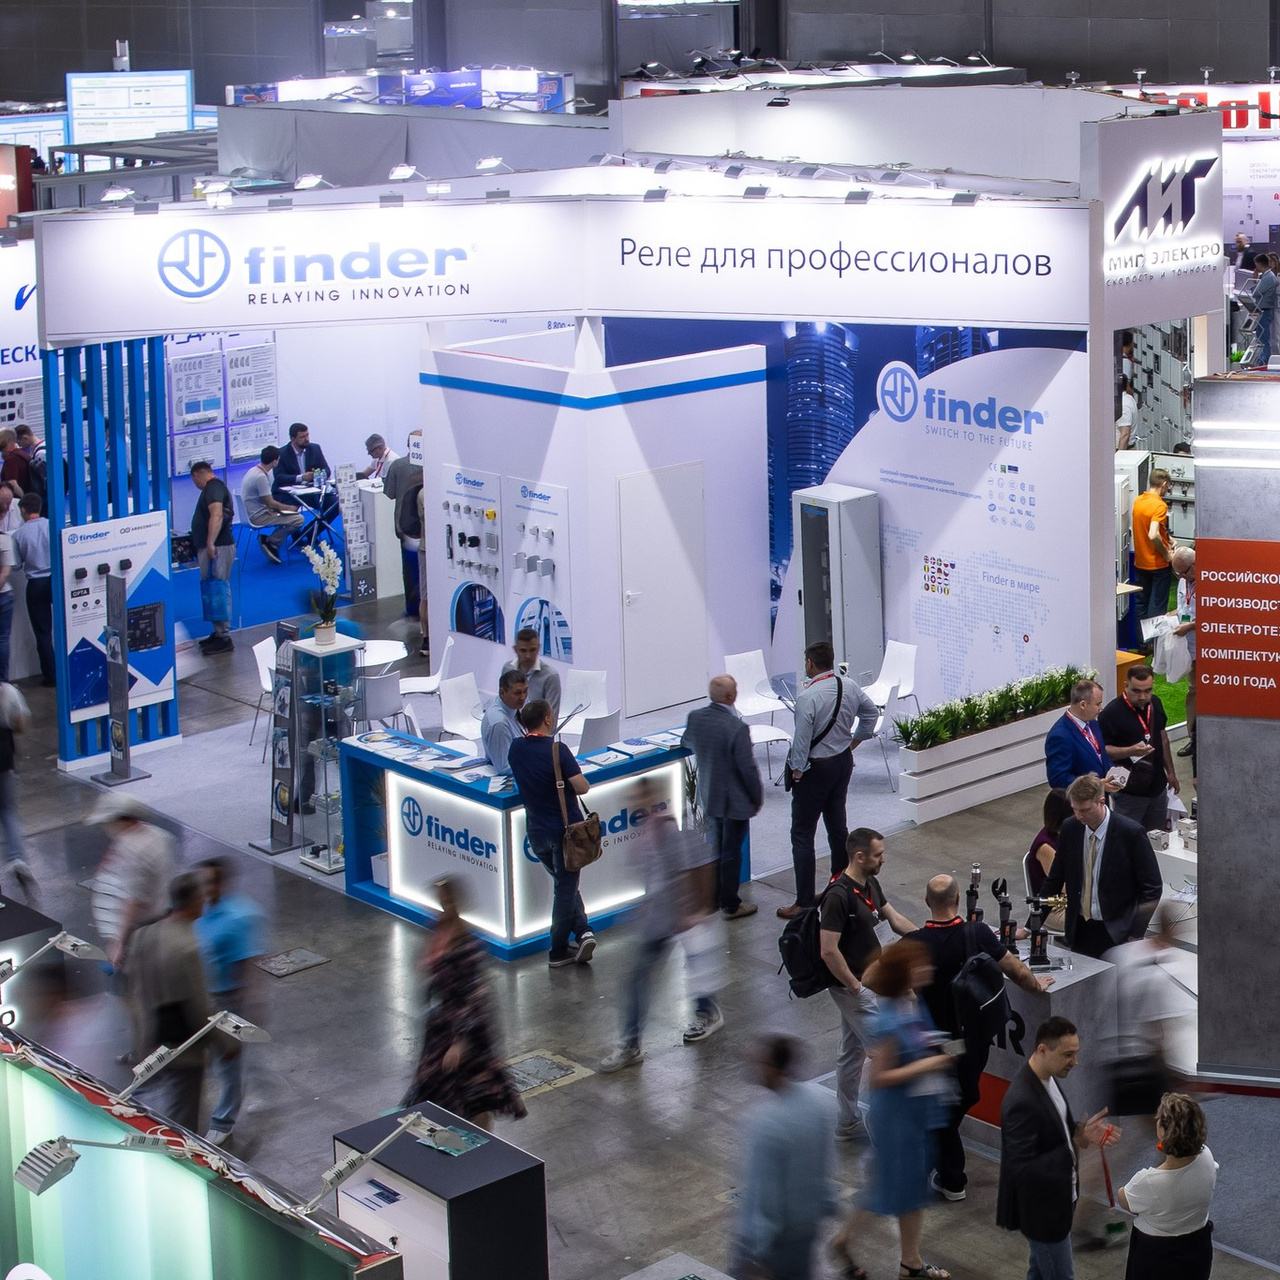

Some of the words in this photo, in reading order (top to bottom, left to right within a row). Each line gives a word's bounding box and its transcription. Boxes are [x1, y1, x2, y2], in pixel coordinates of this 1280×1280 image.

[243, 242, 469, 284] finder
[620, 237, 692, 268] Реле
[701, 242, 756, 273] для
[766, 241, 1052, 279] профессионалов
[1108, 253, 1144, 271] МИГ
[1151, 243, 1220, 265] ЭЛЕКТРО
[248, 289, 341, 305] RELAYING
[351, 284, 471, 302] INNOVATION
[923, 387, 1044, 435] finder
[925, 425, 959, 439] SWITCH
[963, 430, 975, 442] TO
[979, 433, 995, 445] THE
[999, 436, 1032, 451] FUTURE
[463, 477, 484, 488] finder
[528, 490, 551, 501] finder
[79, 531, 110, 542] finder
[982, 571, 1009, 587] Finder
[1017, 581, 1040, 594] мире
[1201, 674, 1210, 684] С
[1213, 675, 1240, 686] 2010
[1243, 676, 1276, 689] ГОДА
[426, 814, 498, 860] finder
[427, 840, 457, 859] RELAYING
[459, 851, 499, 873] INNOVATION
